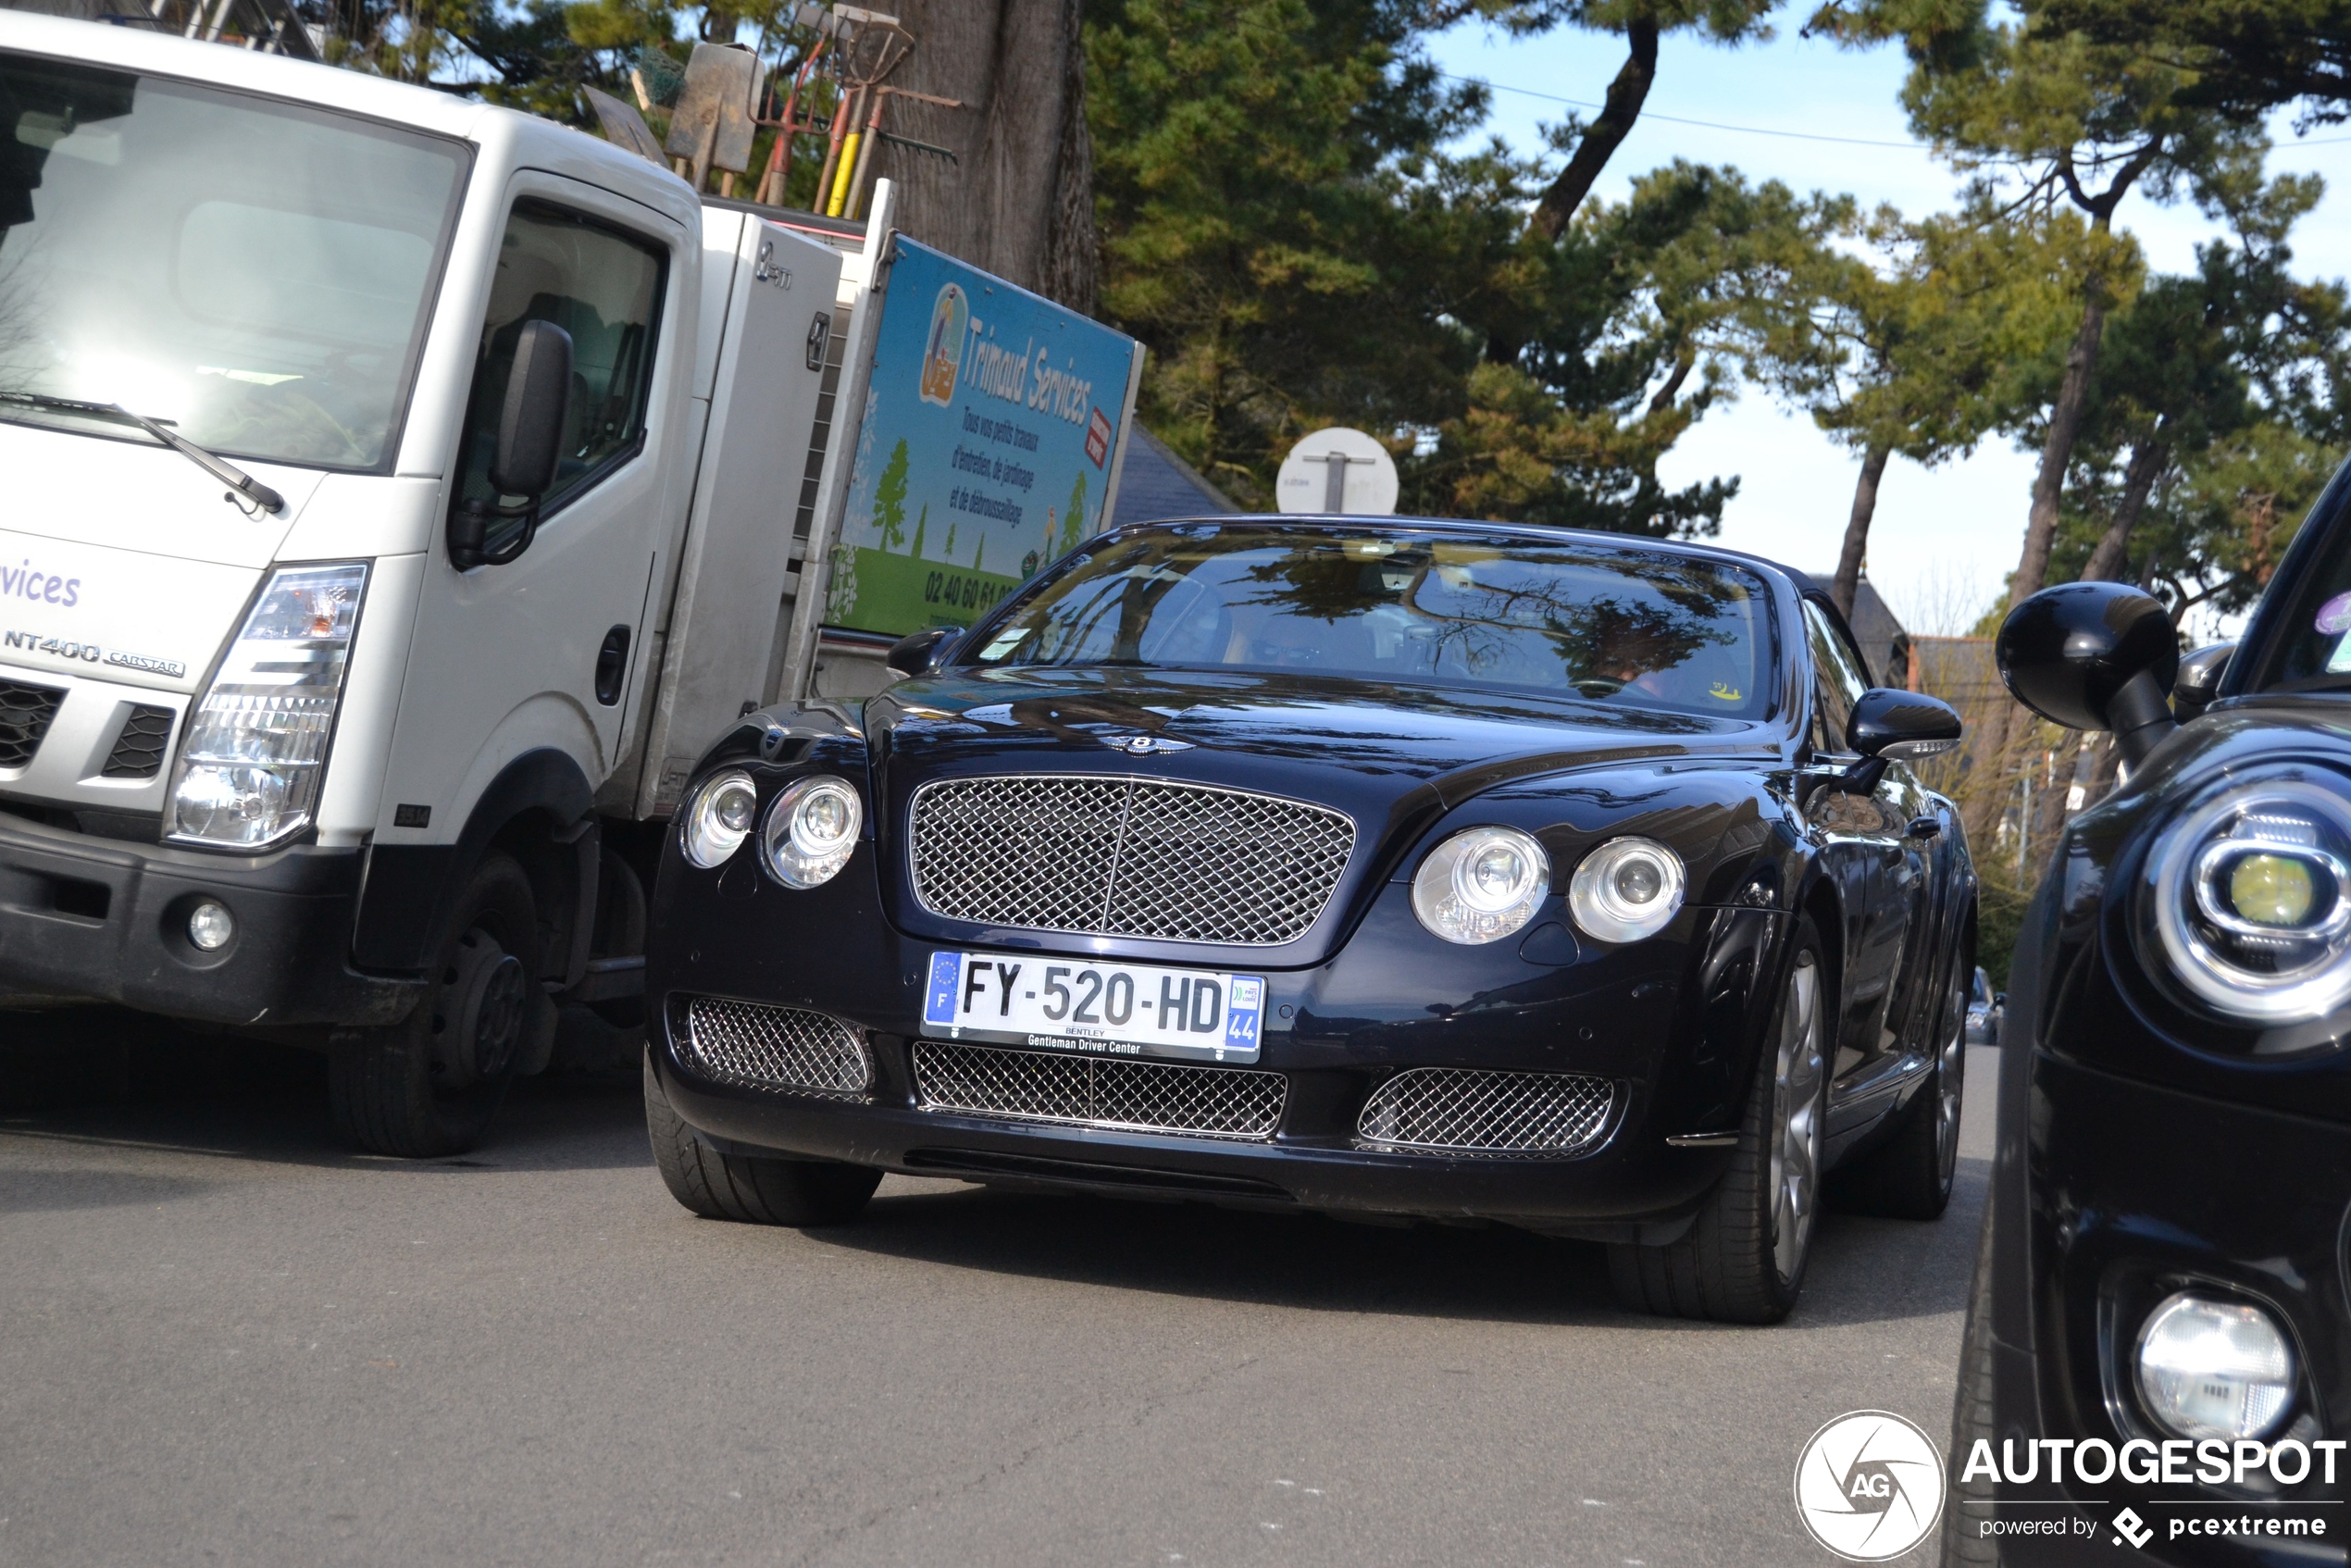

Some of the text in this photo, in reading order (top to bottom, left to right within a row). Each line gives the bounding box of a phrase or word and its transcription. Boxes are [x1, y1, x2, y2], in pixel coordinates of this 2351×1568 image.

[964, 316, 1091, 427] Trimaud Services
[963, 405, 980, 434] Tous
[992, 418, 1014, 444] petits
[992, 456, 1003, 481] de
[1001, 458, 1035, 493] jardinage
[950, 485, 960, 509] et
[958, 486, 969, 512] de
[0, 558, 81, 607] vices
[926, 570, 943, 603] 02
[944, 574, 962, 605] 40
[962, 578, 979, 609] 60
[980, 581, 996, 611] 61
[5, 629, 180, 675] NT400 CABSTAR
[937, 992, 948, 1008] F
[963, 960, 1222, 1034] FY-520-HD
[1027, 1034, 1141, 1054] Gentleman Driver Center
[1065, 1027, 1105, 1038] BENTLEY
[1228, 1014, 1255, 1040] 44
